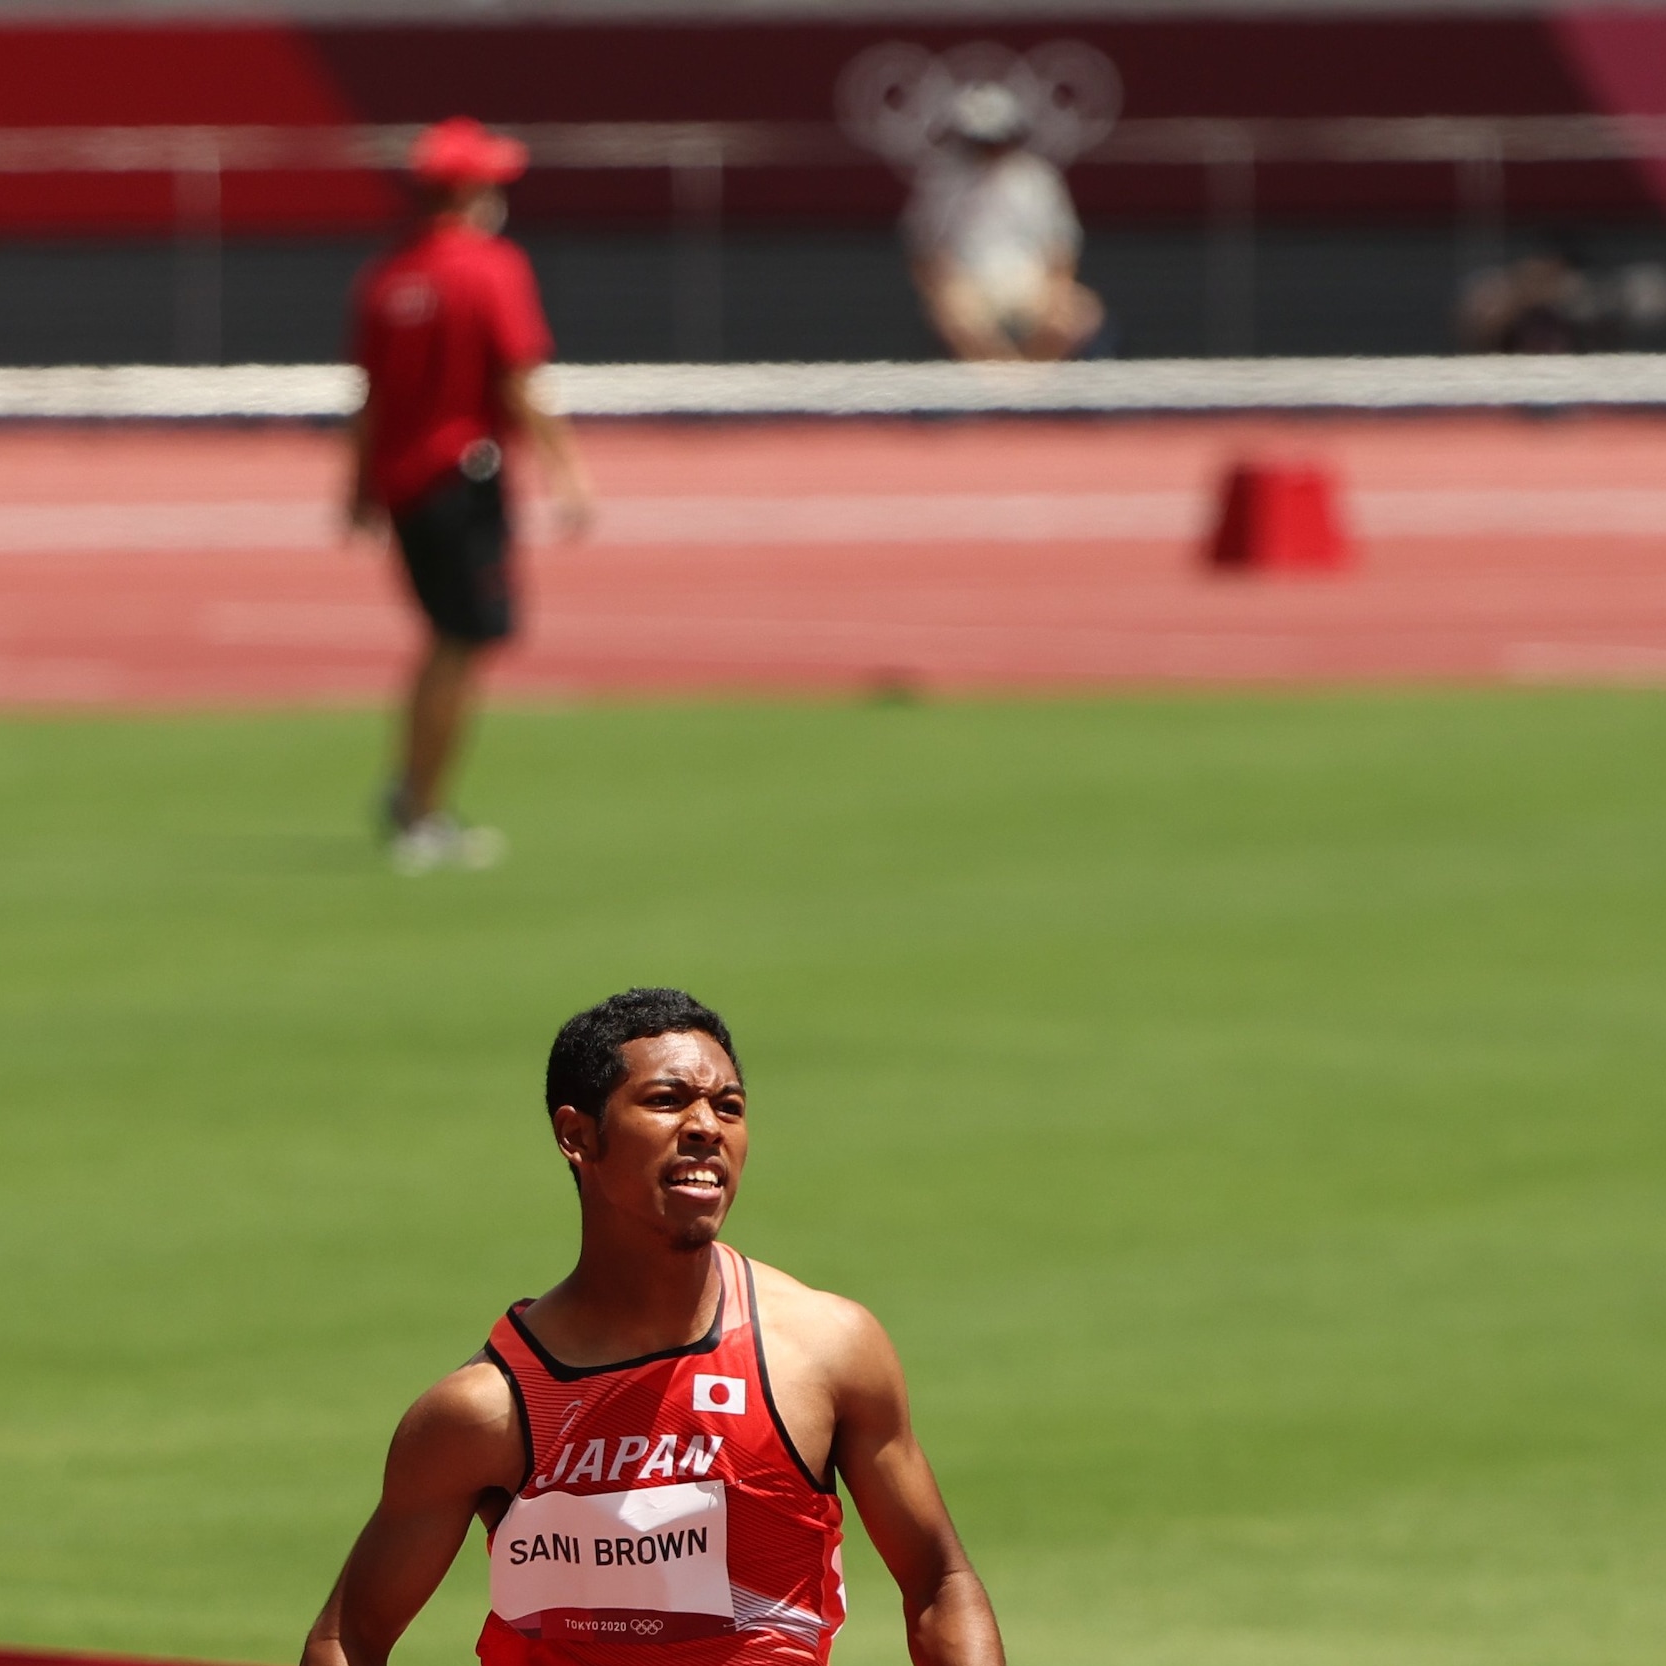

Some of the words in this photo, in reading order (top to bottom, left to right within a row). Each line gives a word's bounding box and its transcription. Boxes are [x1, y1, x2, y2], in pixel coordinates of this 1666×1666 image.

[535, 1434, 724, 1489] JAPAN
[509, 1533, 581, 1565] SANI
[594, 1526, 708, 1566] BROWN
[564, 1618, 599, 1632] TOKYO
[600, 1621, 627, 1632] 2020
